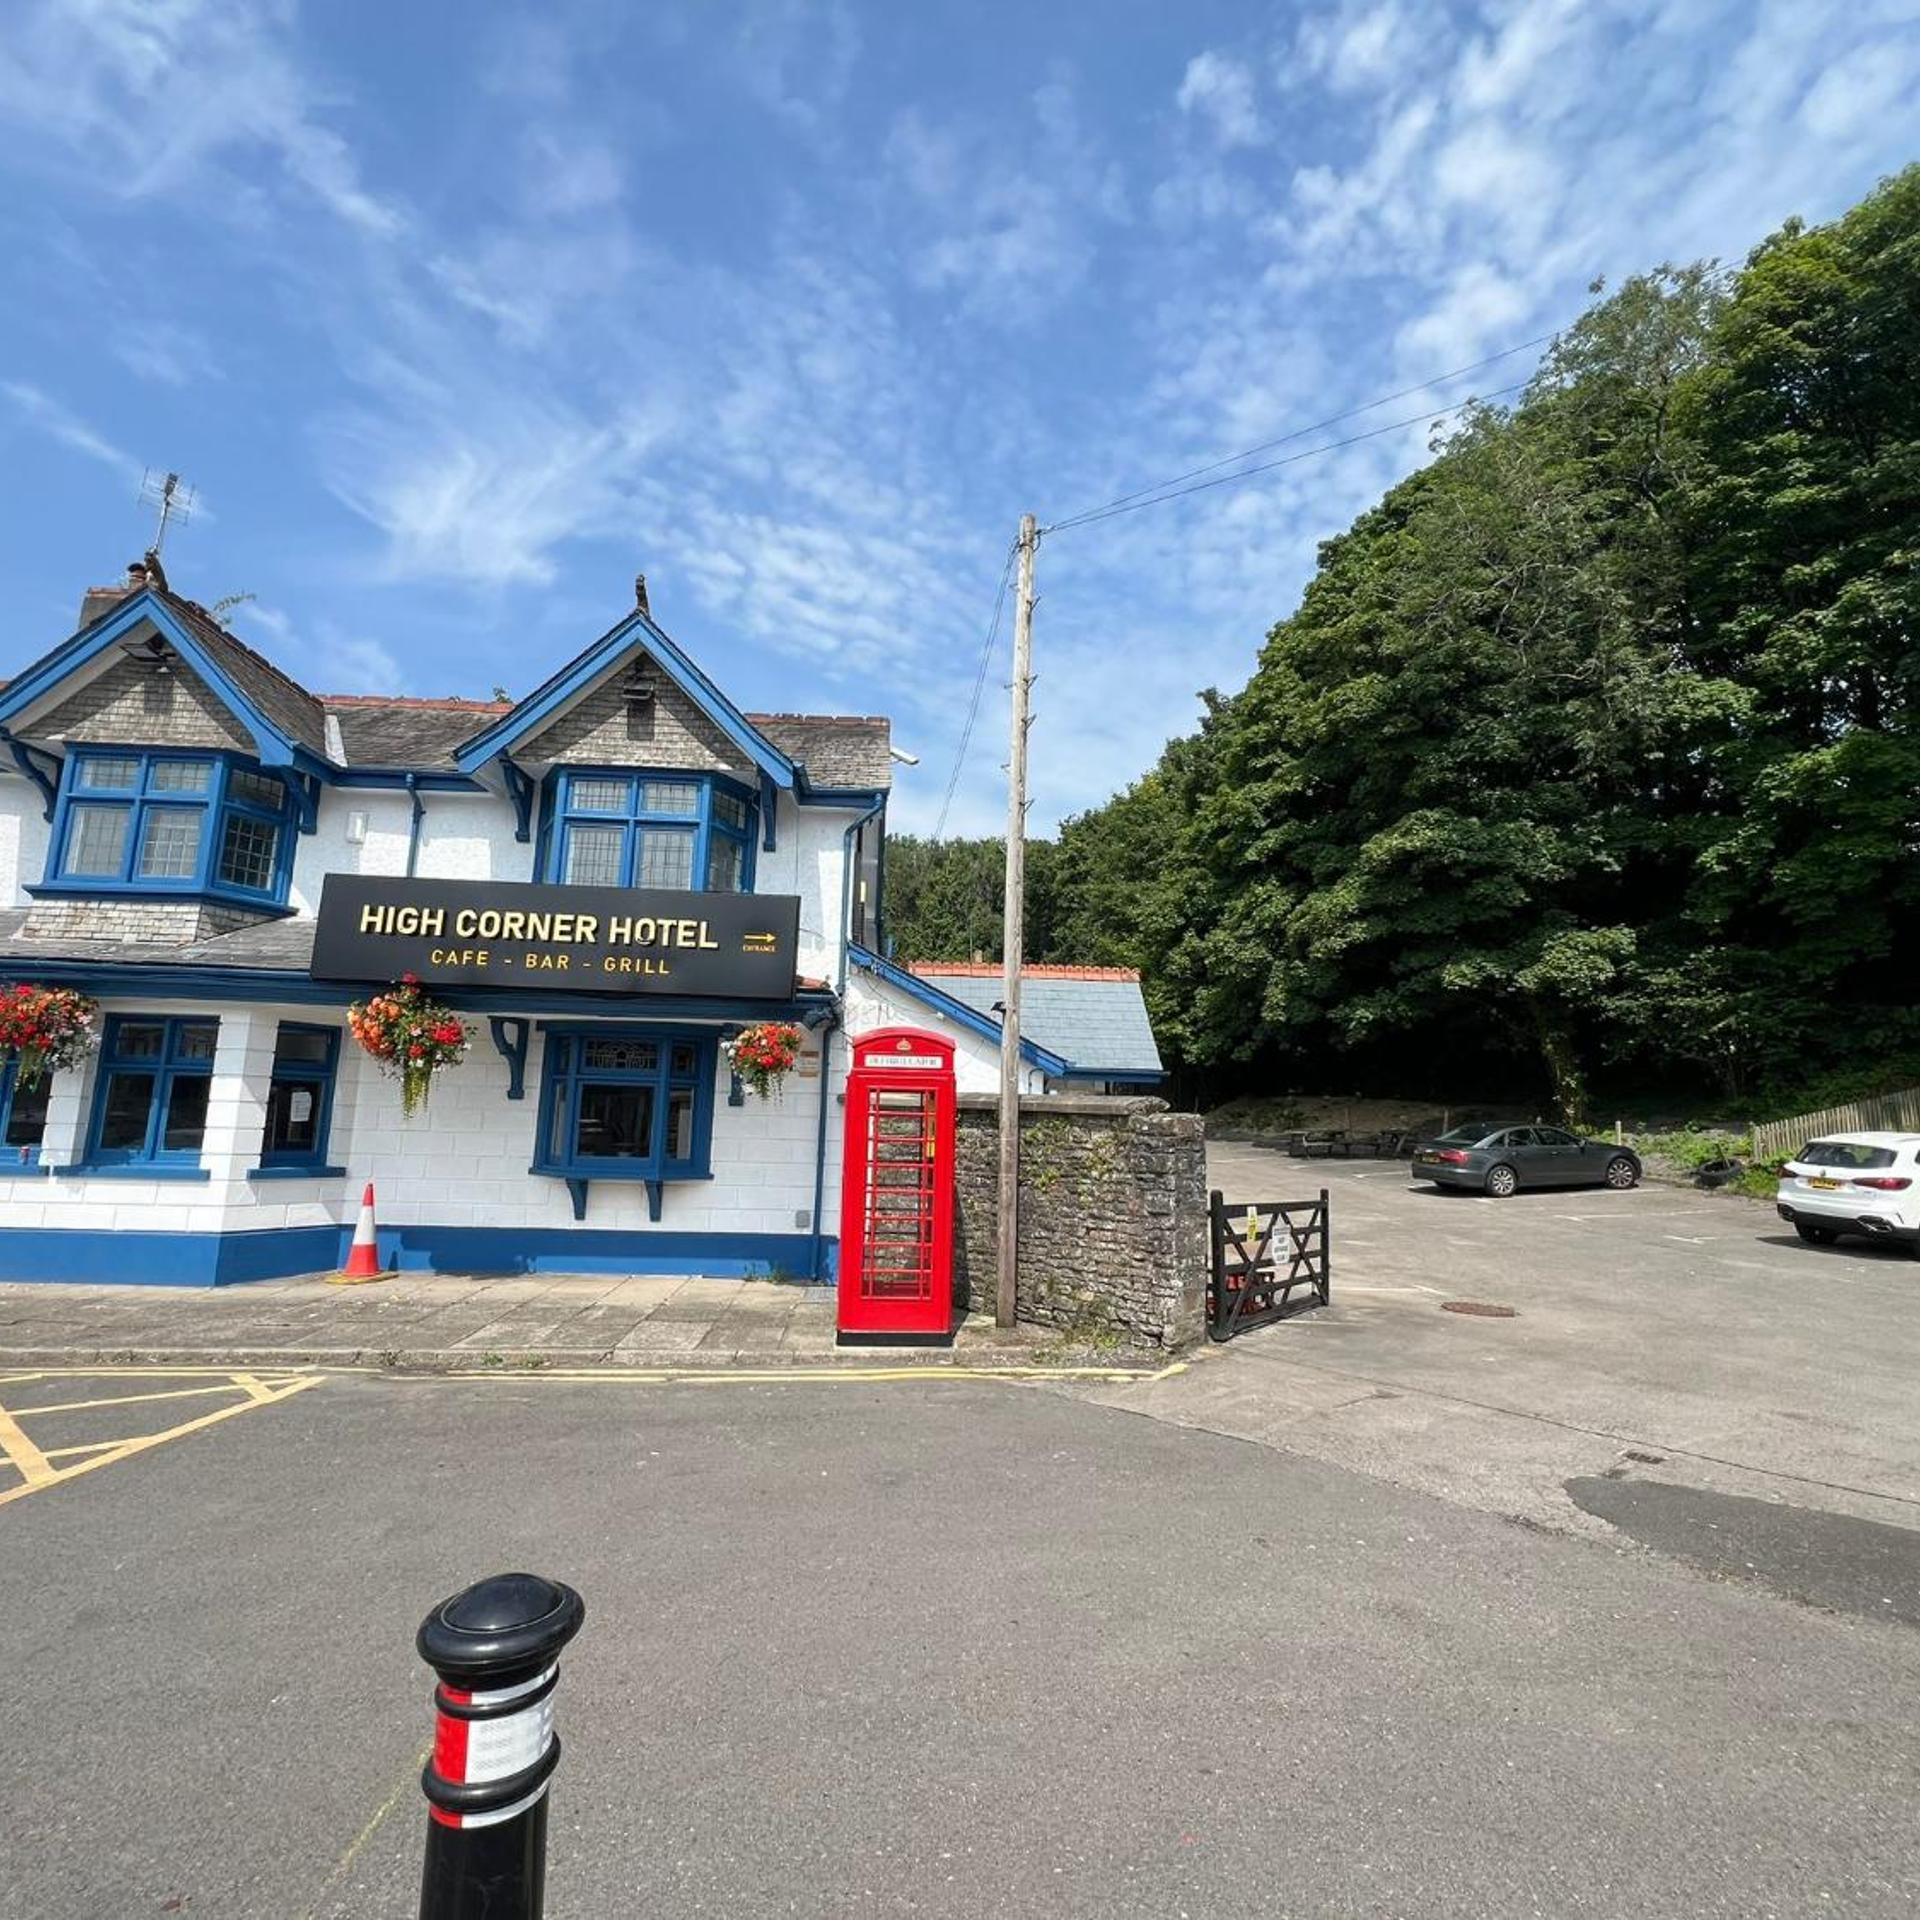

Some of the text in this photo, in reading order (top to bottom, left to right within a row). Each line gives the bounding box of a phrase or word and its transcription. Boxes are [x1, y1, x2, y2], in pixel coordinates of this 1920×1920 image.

[360, 905, 718, 949] HIGH CORNER HOTEL
[430, 949, 489, 966] CAFE
[525, 953, 570, 970] BAR
[603, 956, 670, 975] GRILL
